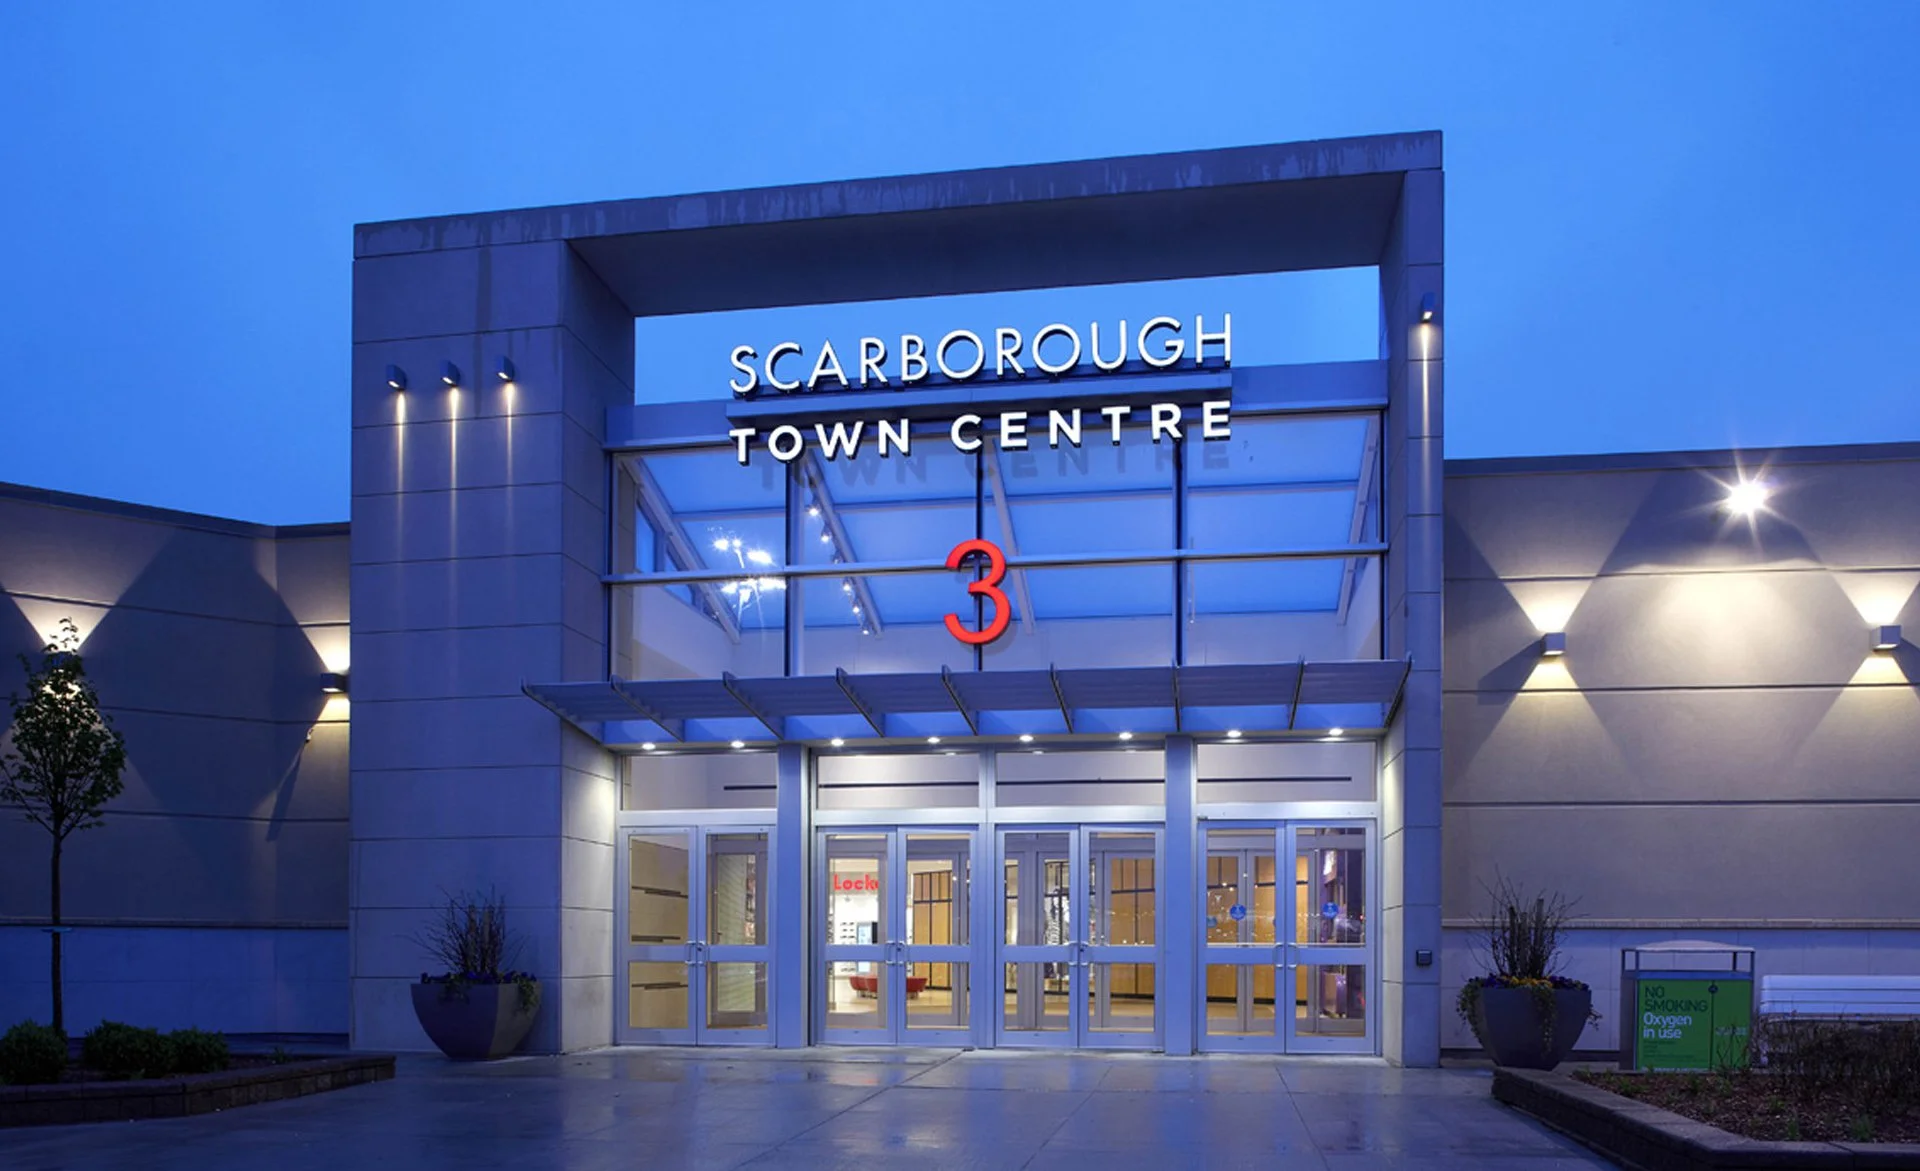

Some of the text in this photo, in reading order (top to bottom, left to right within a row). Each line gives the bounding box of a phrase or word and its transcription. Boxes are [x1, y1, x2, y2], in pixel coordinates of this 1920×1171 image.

[729, 313, 1232, 395] SCARBOROUGH
[729, 400, 1232, 464] TOWN CENTRE
[943, 538, 1011, 645] 3
[1644, 986, 1665, 998] NO
[1644, 999, 1708, 1012] SMOKING
[1643, 1012, 1692, 1029] Oxygen
[1643, 1026, 1682, 1038] in use
